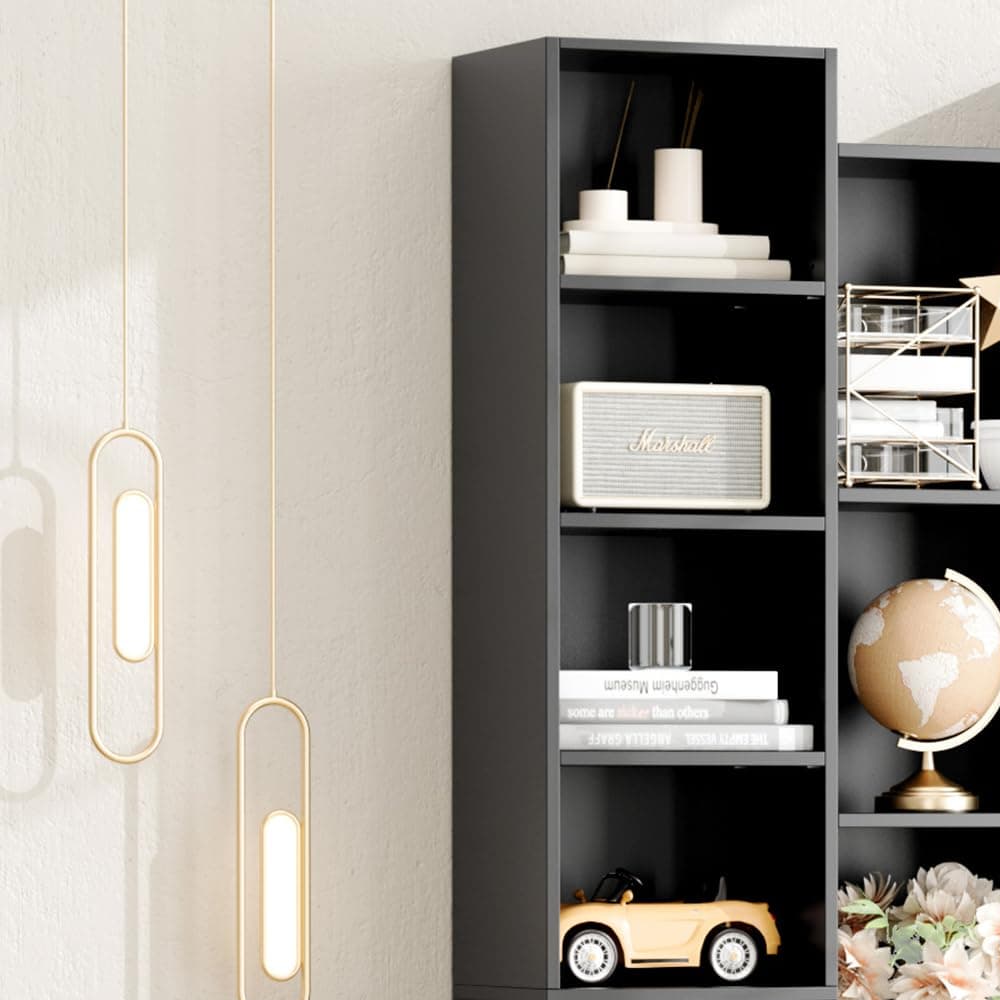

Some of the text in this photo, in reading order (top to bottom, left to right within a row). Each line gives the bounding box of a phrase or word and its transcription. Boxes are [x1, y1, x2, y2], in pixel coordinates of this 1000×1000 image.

[628, 428, 715, 454] Marshall
[604, 676, 719, 694] Guggenheim Museum
